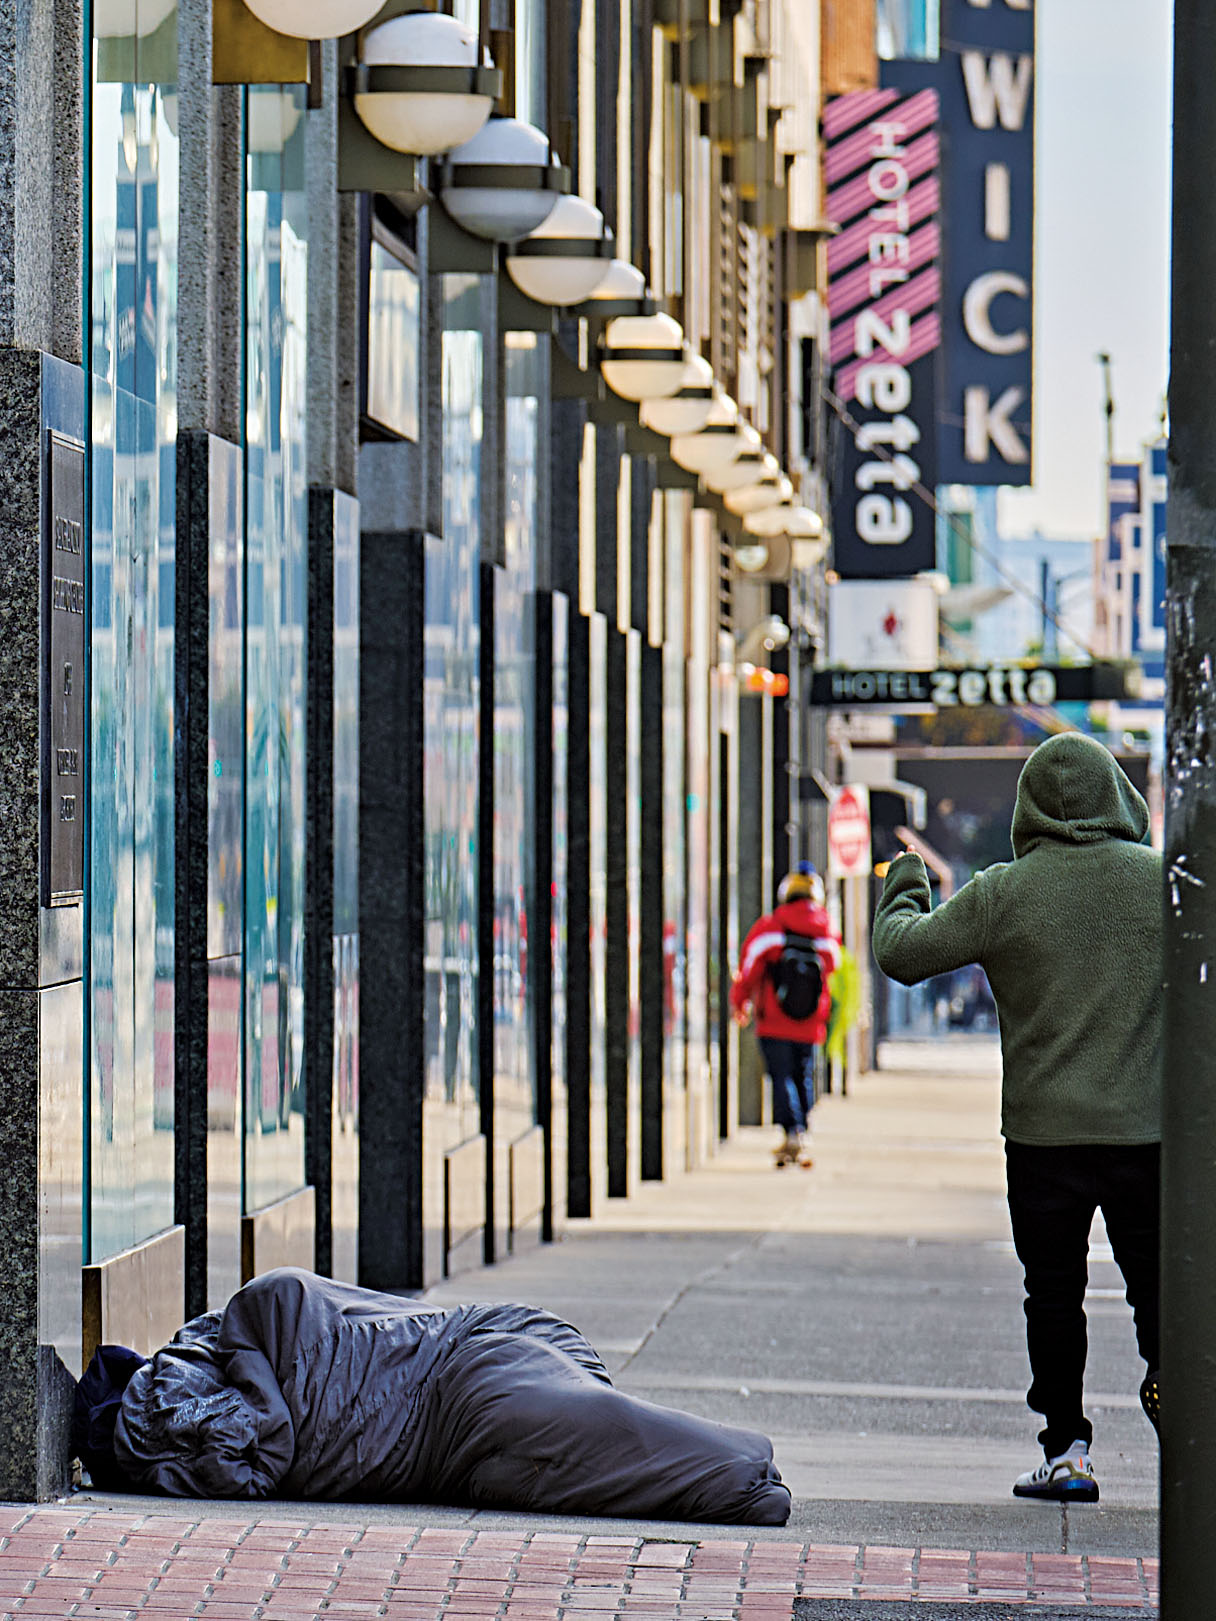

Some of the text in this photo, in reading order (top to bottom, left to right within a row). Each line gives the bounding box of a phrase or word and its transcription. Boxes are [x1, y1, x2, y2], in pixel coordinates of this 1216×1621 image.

[854, 121, 921, 545] HOTEL zetta
[961, 0, 1033, 464] WICK
[833, 666, 1057, 706] HOTEL zetta
